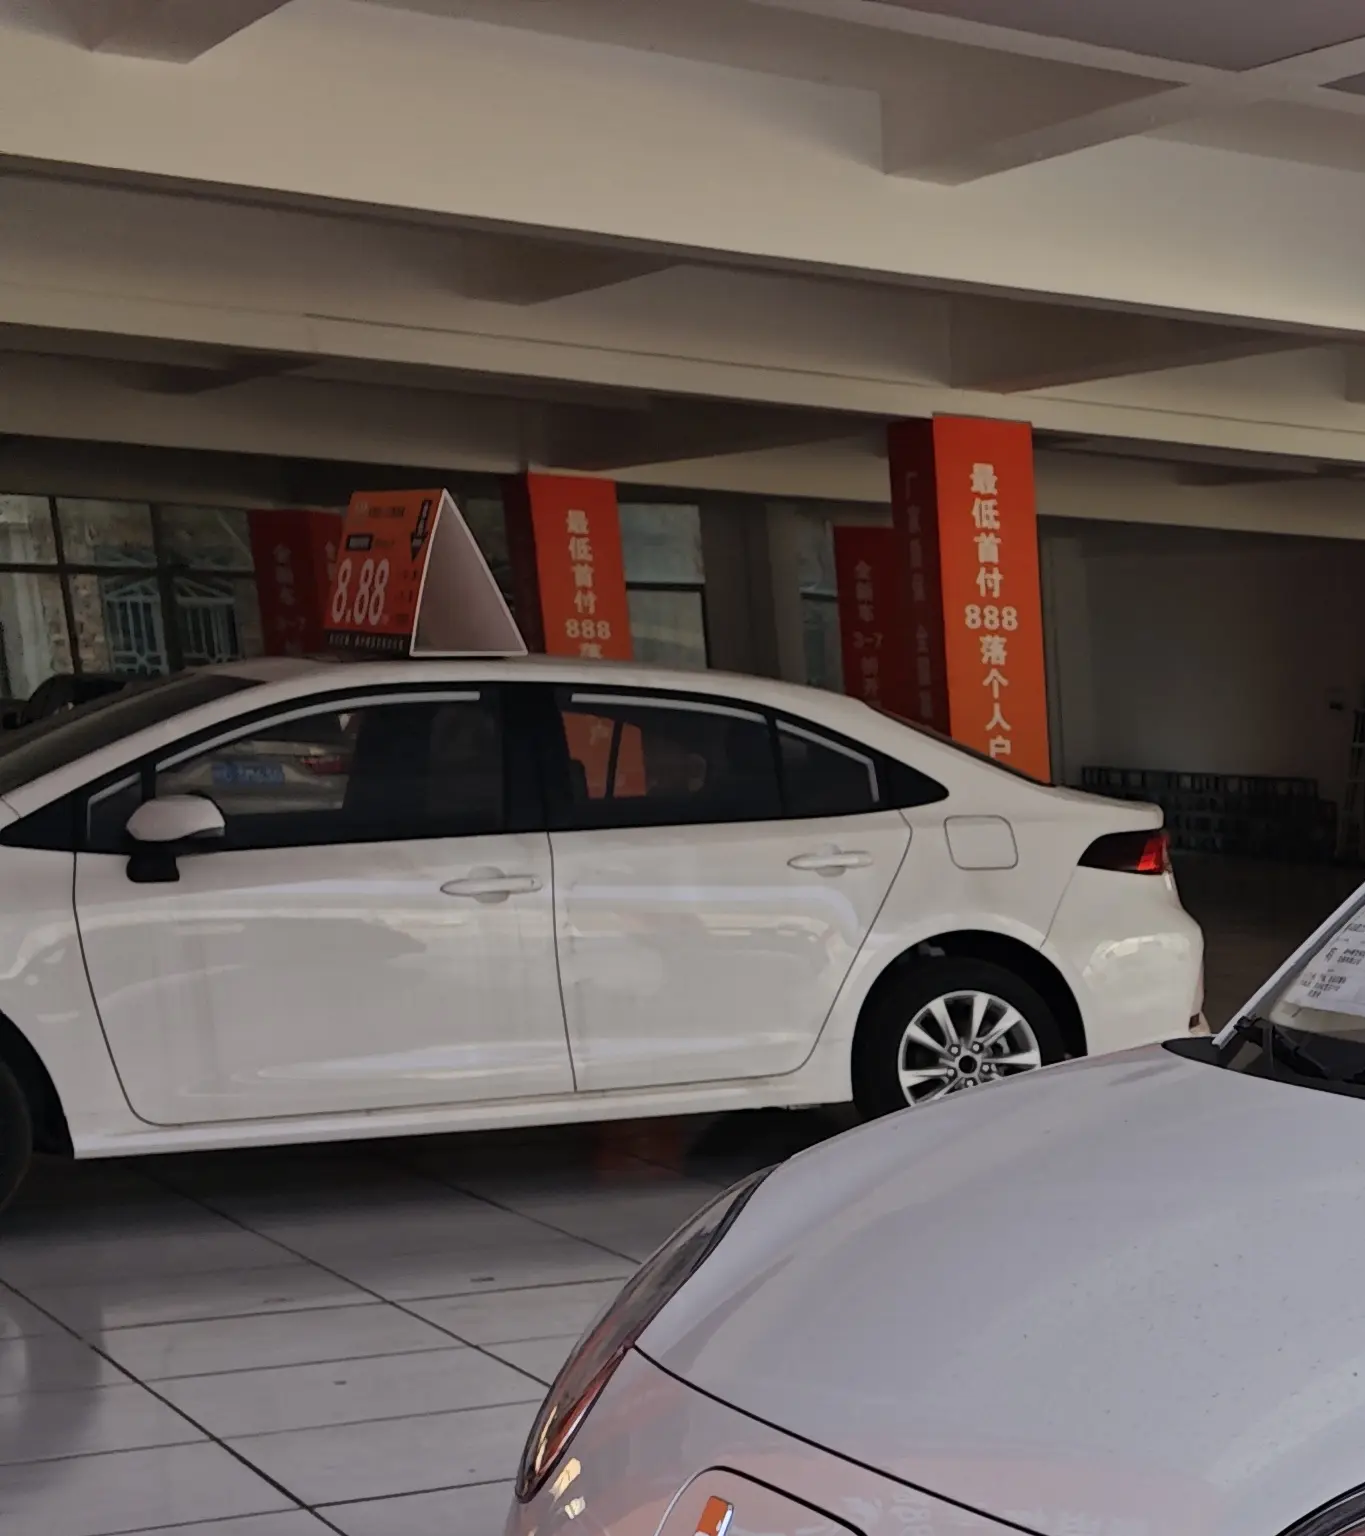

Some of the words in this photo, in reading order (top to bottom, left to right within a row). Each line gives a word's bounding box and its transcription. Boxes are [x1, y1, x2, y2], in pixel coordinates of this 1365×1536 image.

[964, 462, 1018, 758] 最低首付888落个人户
